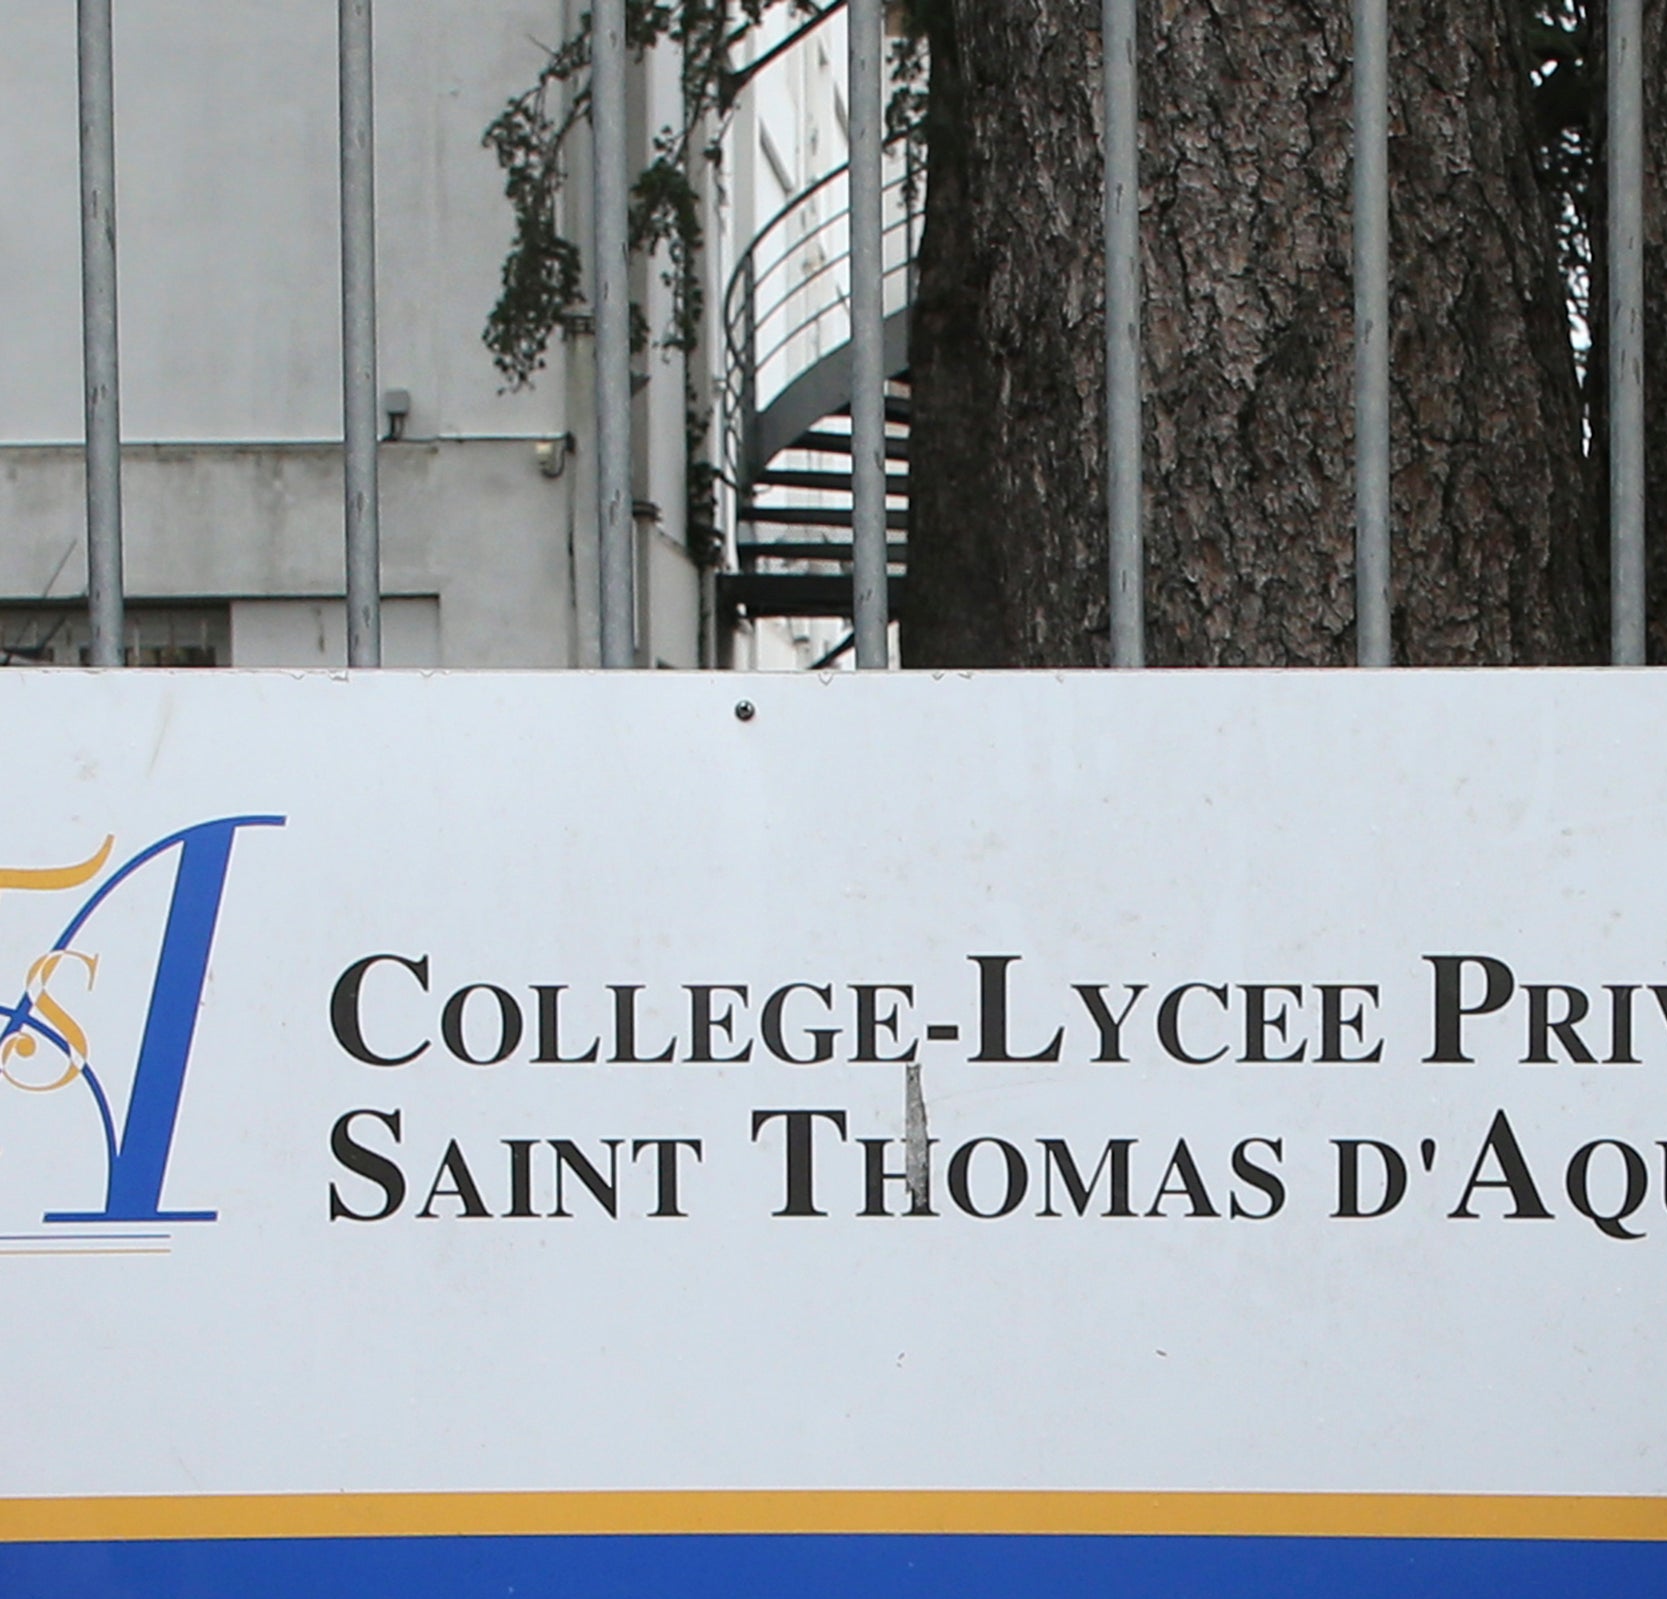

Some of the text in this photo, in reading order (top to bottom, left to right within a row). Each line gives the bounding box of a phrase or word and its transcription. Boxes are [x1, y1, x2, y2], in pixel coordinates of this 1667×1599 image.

[328, 953, 1385, 1068] COLLEGE-LYCEE
[328, 1108, 703, 1222] SAINT
[750, 1108, 1287, 1221] THOMAS
